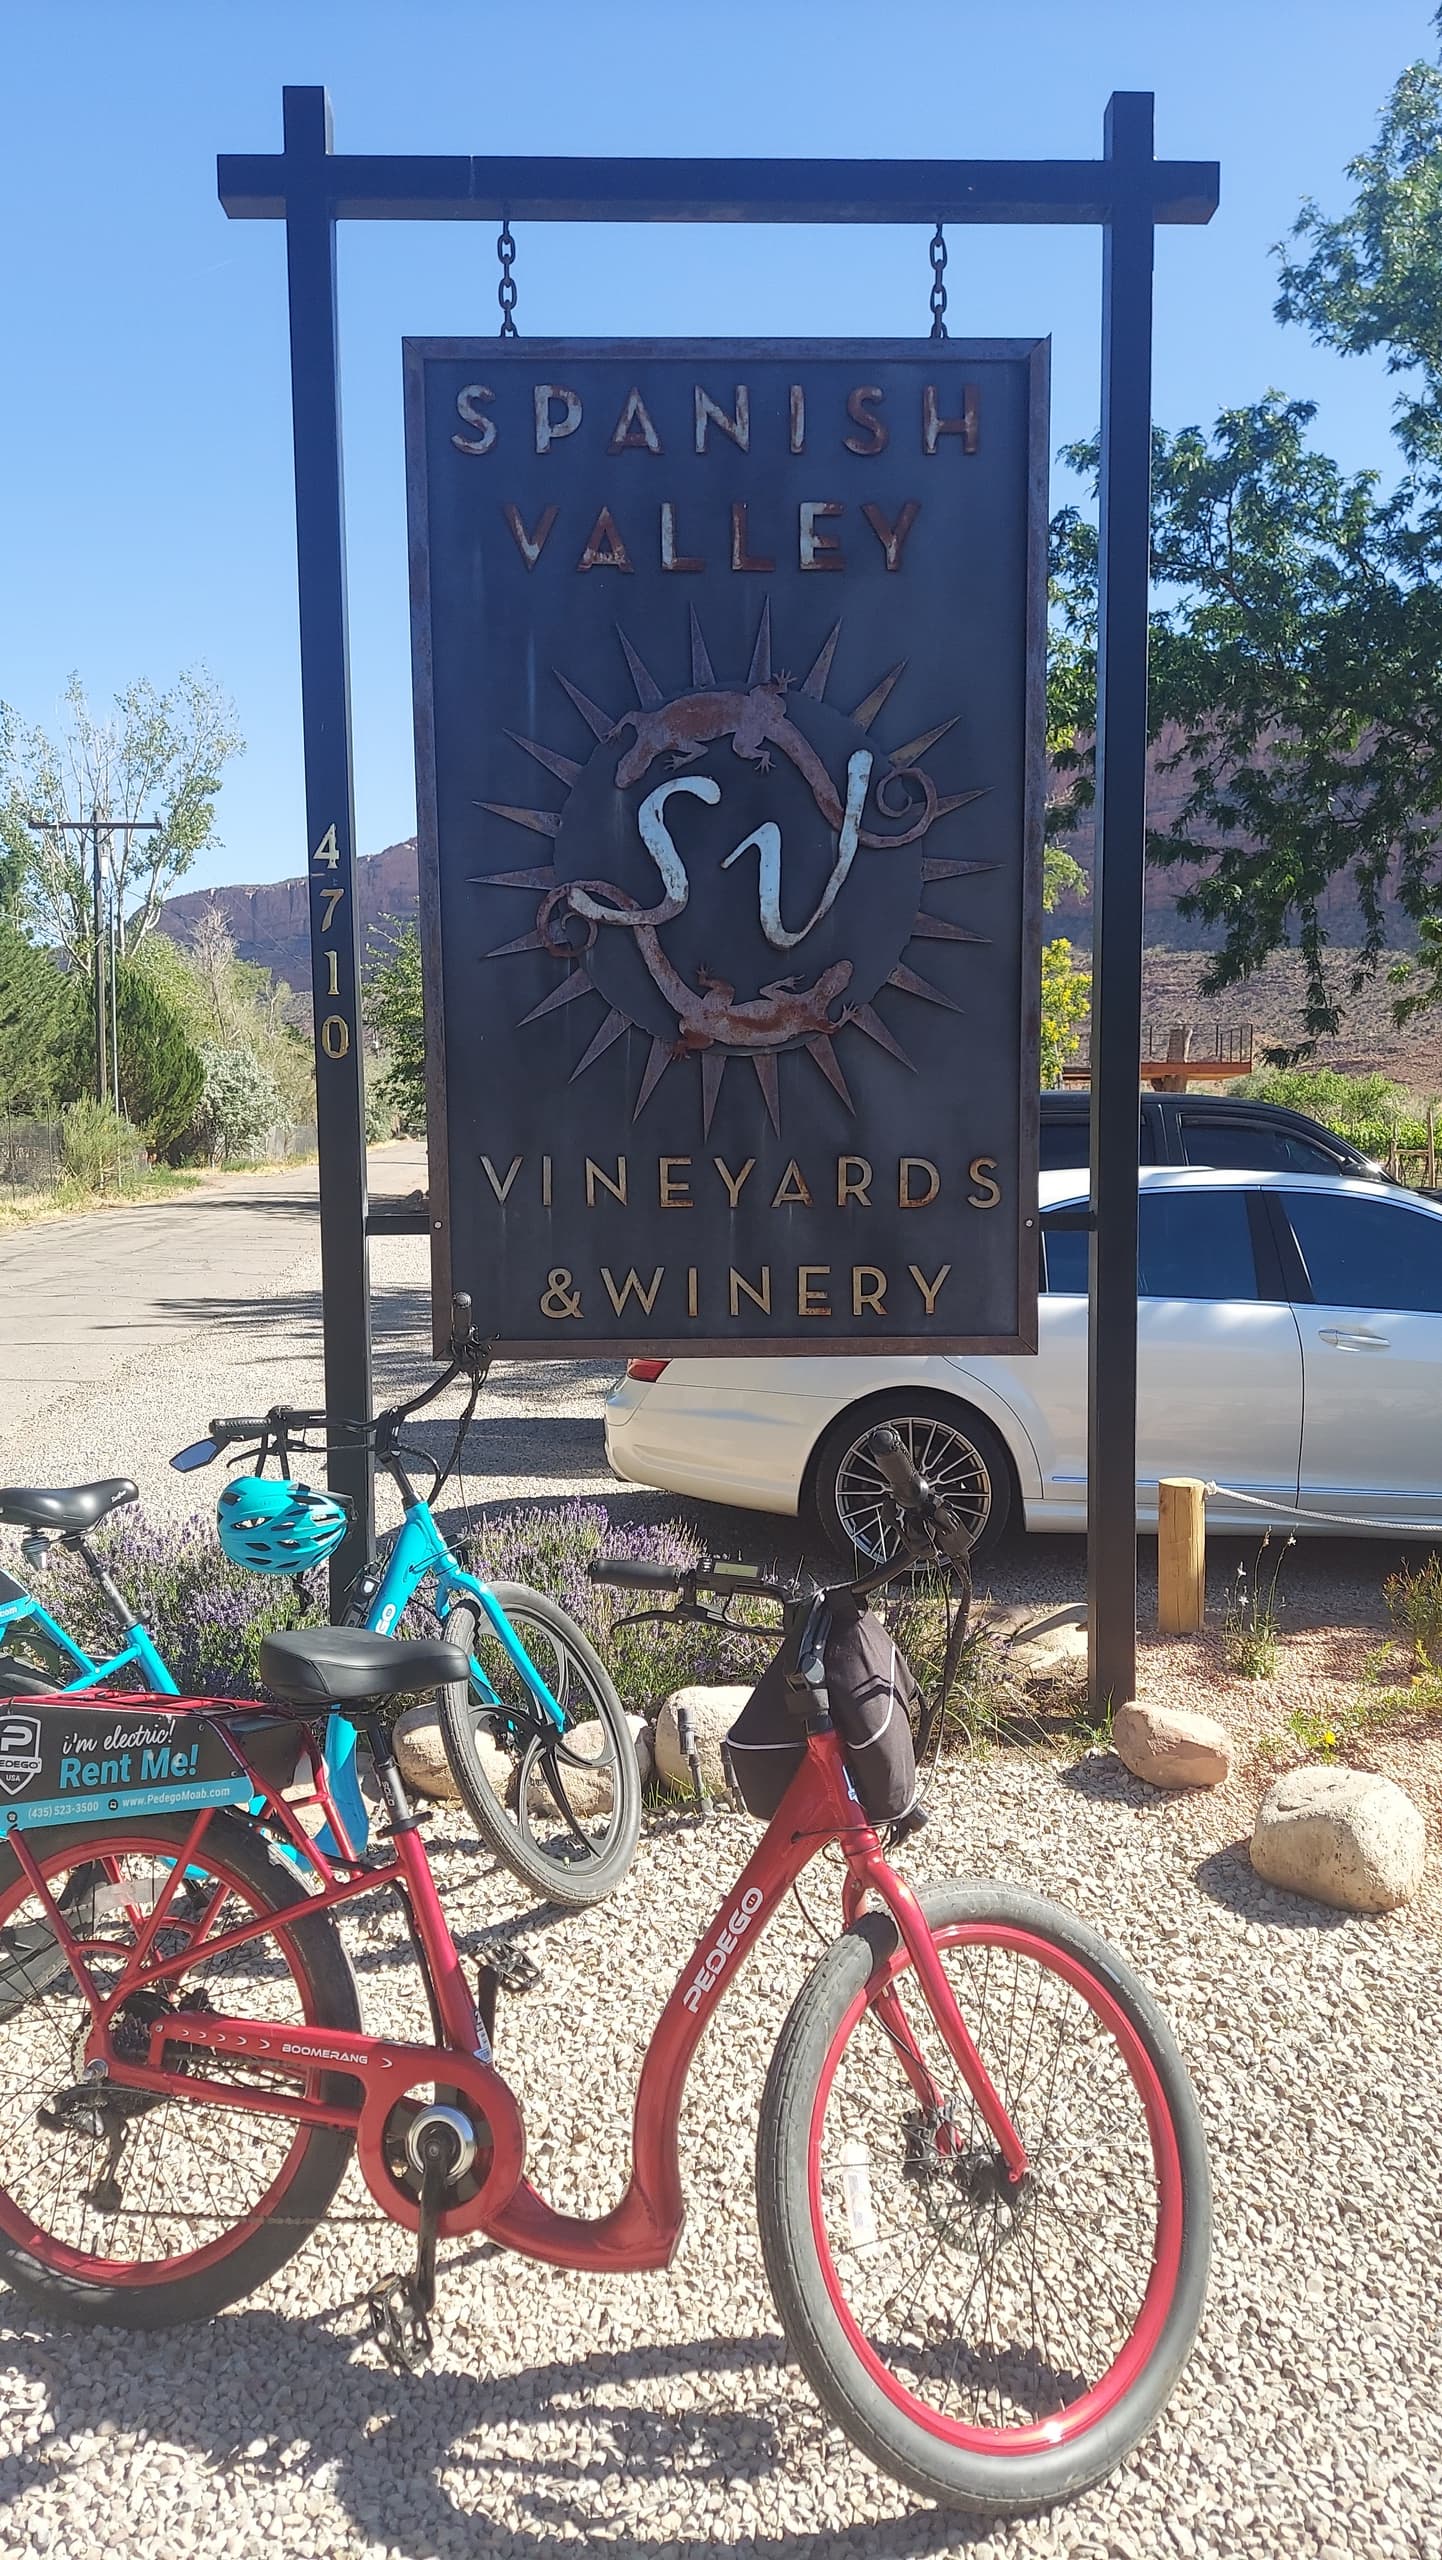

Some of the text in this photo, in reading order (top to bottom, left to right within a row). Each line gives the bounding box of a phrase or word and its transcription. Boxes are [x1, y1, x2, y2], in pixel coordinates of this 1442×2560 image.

[451, 384, 981, 455] SPANISH
[504, 501, 921, 573] VALLEY
[479, 1154, 1001, 1209] VINEYARDS
[62, 1719, 176, 1755] i'm electric!
[6, 1774, 21, 1782] USA
[60, 1744, 199, 1789] Rent Me!
[28, 1801, 99, 1820] (435) 523-3500
[122, 1787, 231, 1808] www.PedegoMoab.com
[683, 1887, 764, 2014] PEDEGO
[282, 2043, 369, 2065] BOOMERANG
